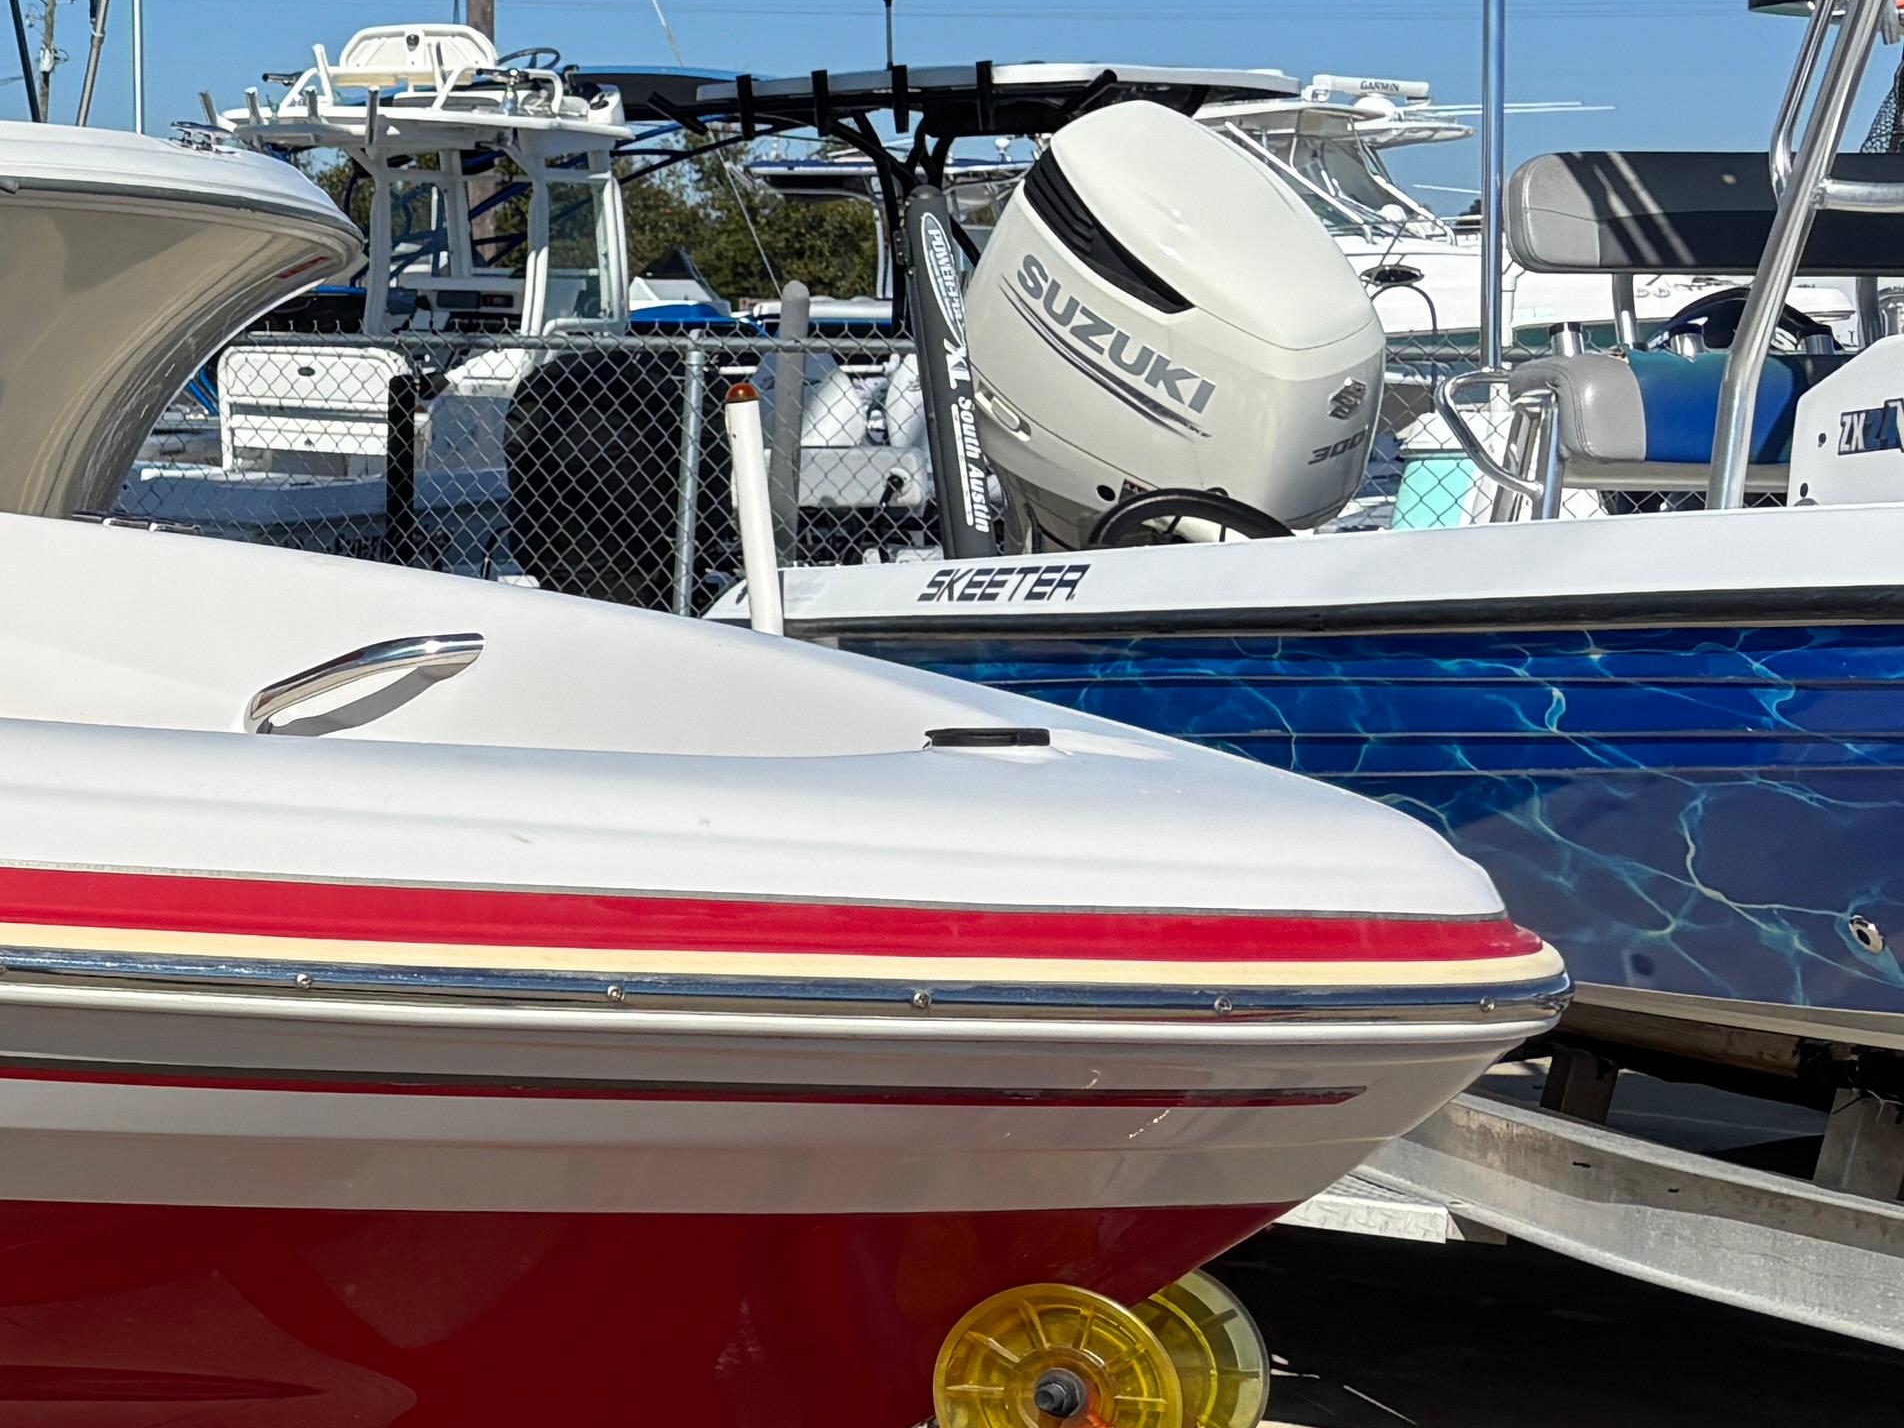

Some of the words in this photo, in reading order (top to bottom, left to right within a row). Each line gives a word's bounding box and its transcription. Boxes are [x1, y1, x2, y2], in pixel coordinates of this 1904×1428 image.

[1360, 80, 1400, 92] GARMIN
[943, 337, 971, 390] XL
[1017, 254, 1217, 414] SUZUKI
[958, 395, 982, 460] South
[967, 464, 991, 534] Austin
[917, 564, 1091, 601] SKEETER
